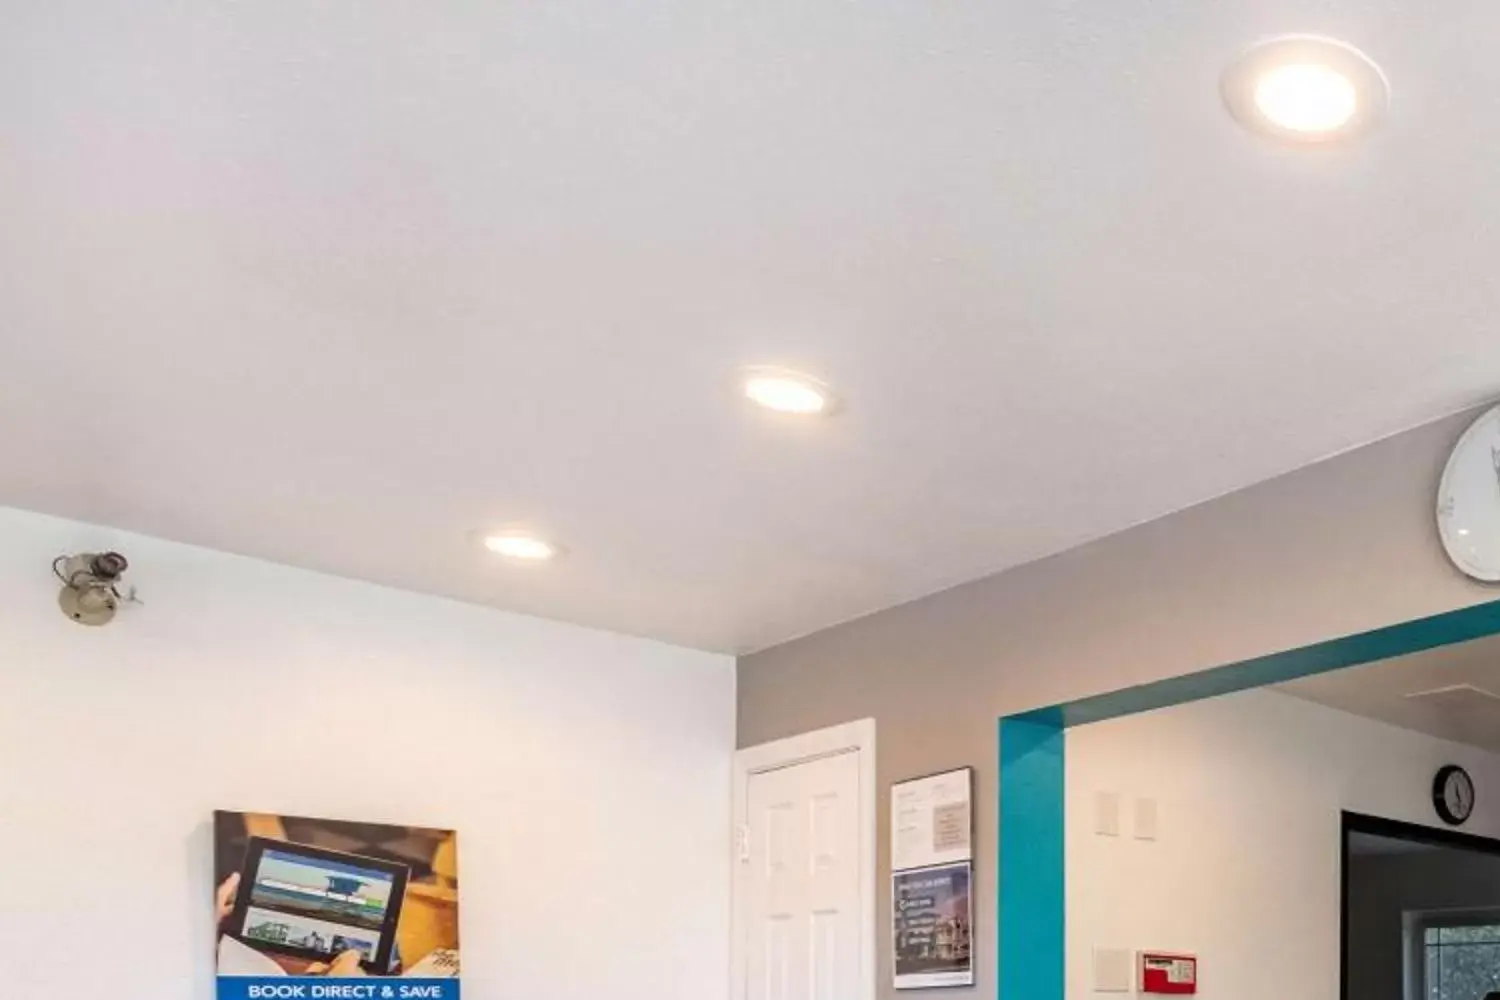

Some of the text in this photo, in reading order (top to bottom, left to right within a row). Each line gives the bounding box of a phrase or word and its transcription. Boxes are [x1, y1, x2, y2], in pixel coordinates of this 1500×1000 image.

[248, 985, 442, 999] BOOK DIRECT & SAVE
